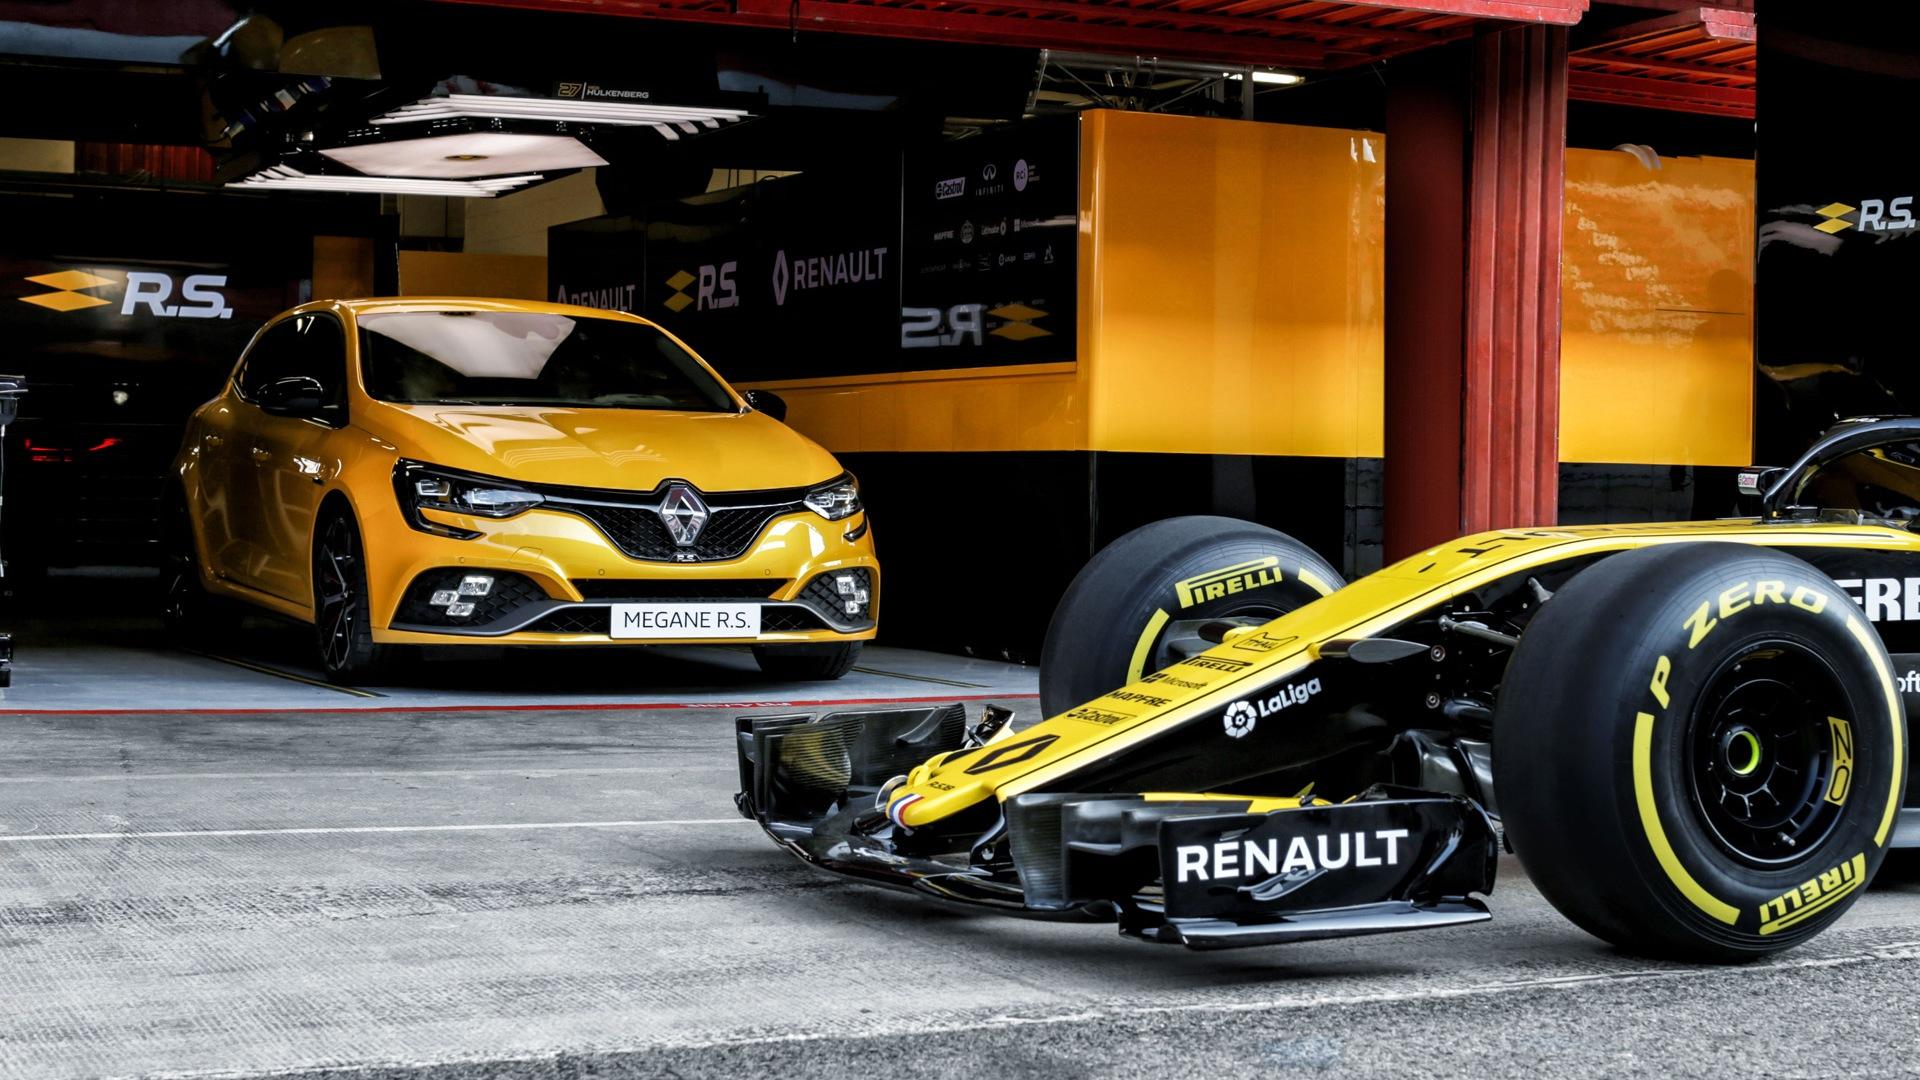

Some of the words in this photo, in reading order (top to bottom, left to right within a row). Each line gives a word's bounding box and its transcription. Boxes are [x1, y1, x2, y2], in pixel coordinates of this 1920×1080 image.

[558, 82, 582, 97] 27
[793, 247, 888, 290] RENAULT
[120, 272, 233, 318] R.S.
[1174, 555, 1283, 609] PIRELLI
[717, 611, 751, 628] R.S.
[1181, 656, 1253, 673] PIRELLI
[1650, 655, 1671, 710] P
[1682, 580, 1828, 650] ZERO
[1106, 691, 1172, 708] MAPFRE
[1257, 677, 1322, 718] LaLiga
[1176, 828, 1409, 883] RENAULT
[1758, 852, 1866, 936] PIRELLI
